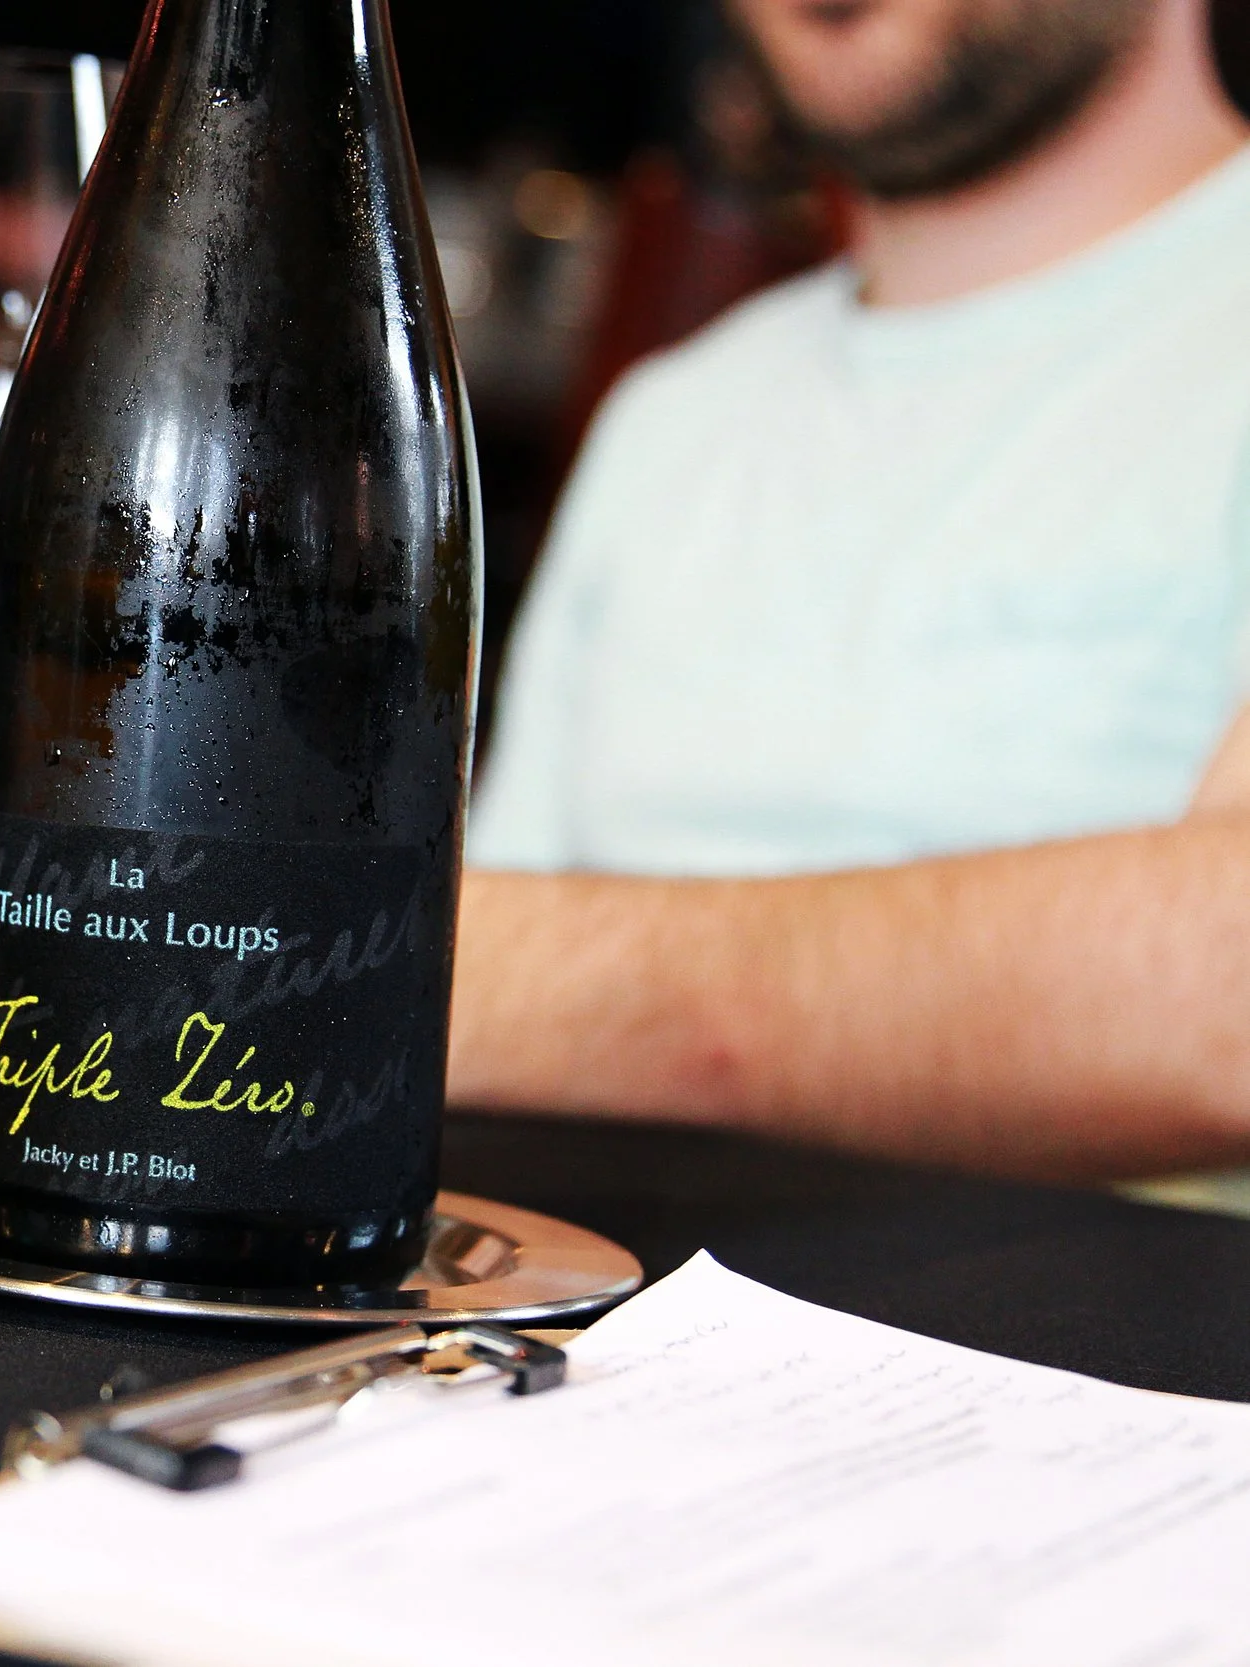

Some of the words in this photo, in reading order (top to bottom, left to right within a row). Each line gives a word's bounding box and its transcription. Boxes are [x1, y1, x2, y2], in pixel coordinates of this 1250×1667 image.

[109, 857, 146, 890] La
[83, 911, 149, 943] aux
[165, 911, 279, 961] Loups
[22, 1136, 75, 1173] Jacky
[78, 1153, 100, 1172] et
[104, 1150, 139, 1177] J.P.
[148, 1154, 197, 1182] Blot
